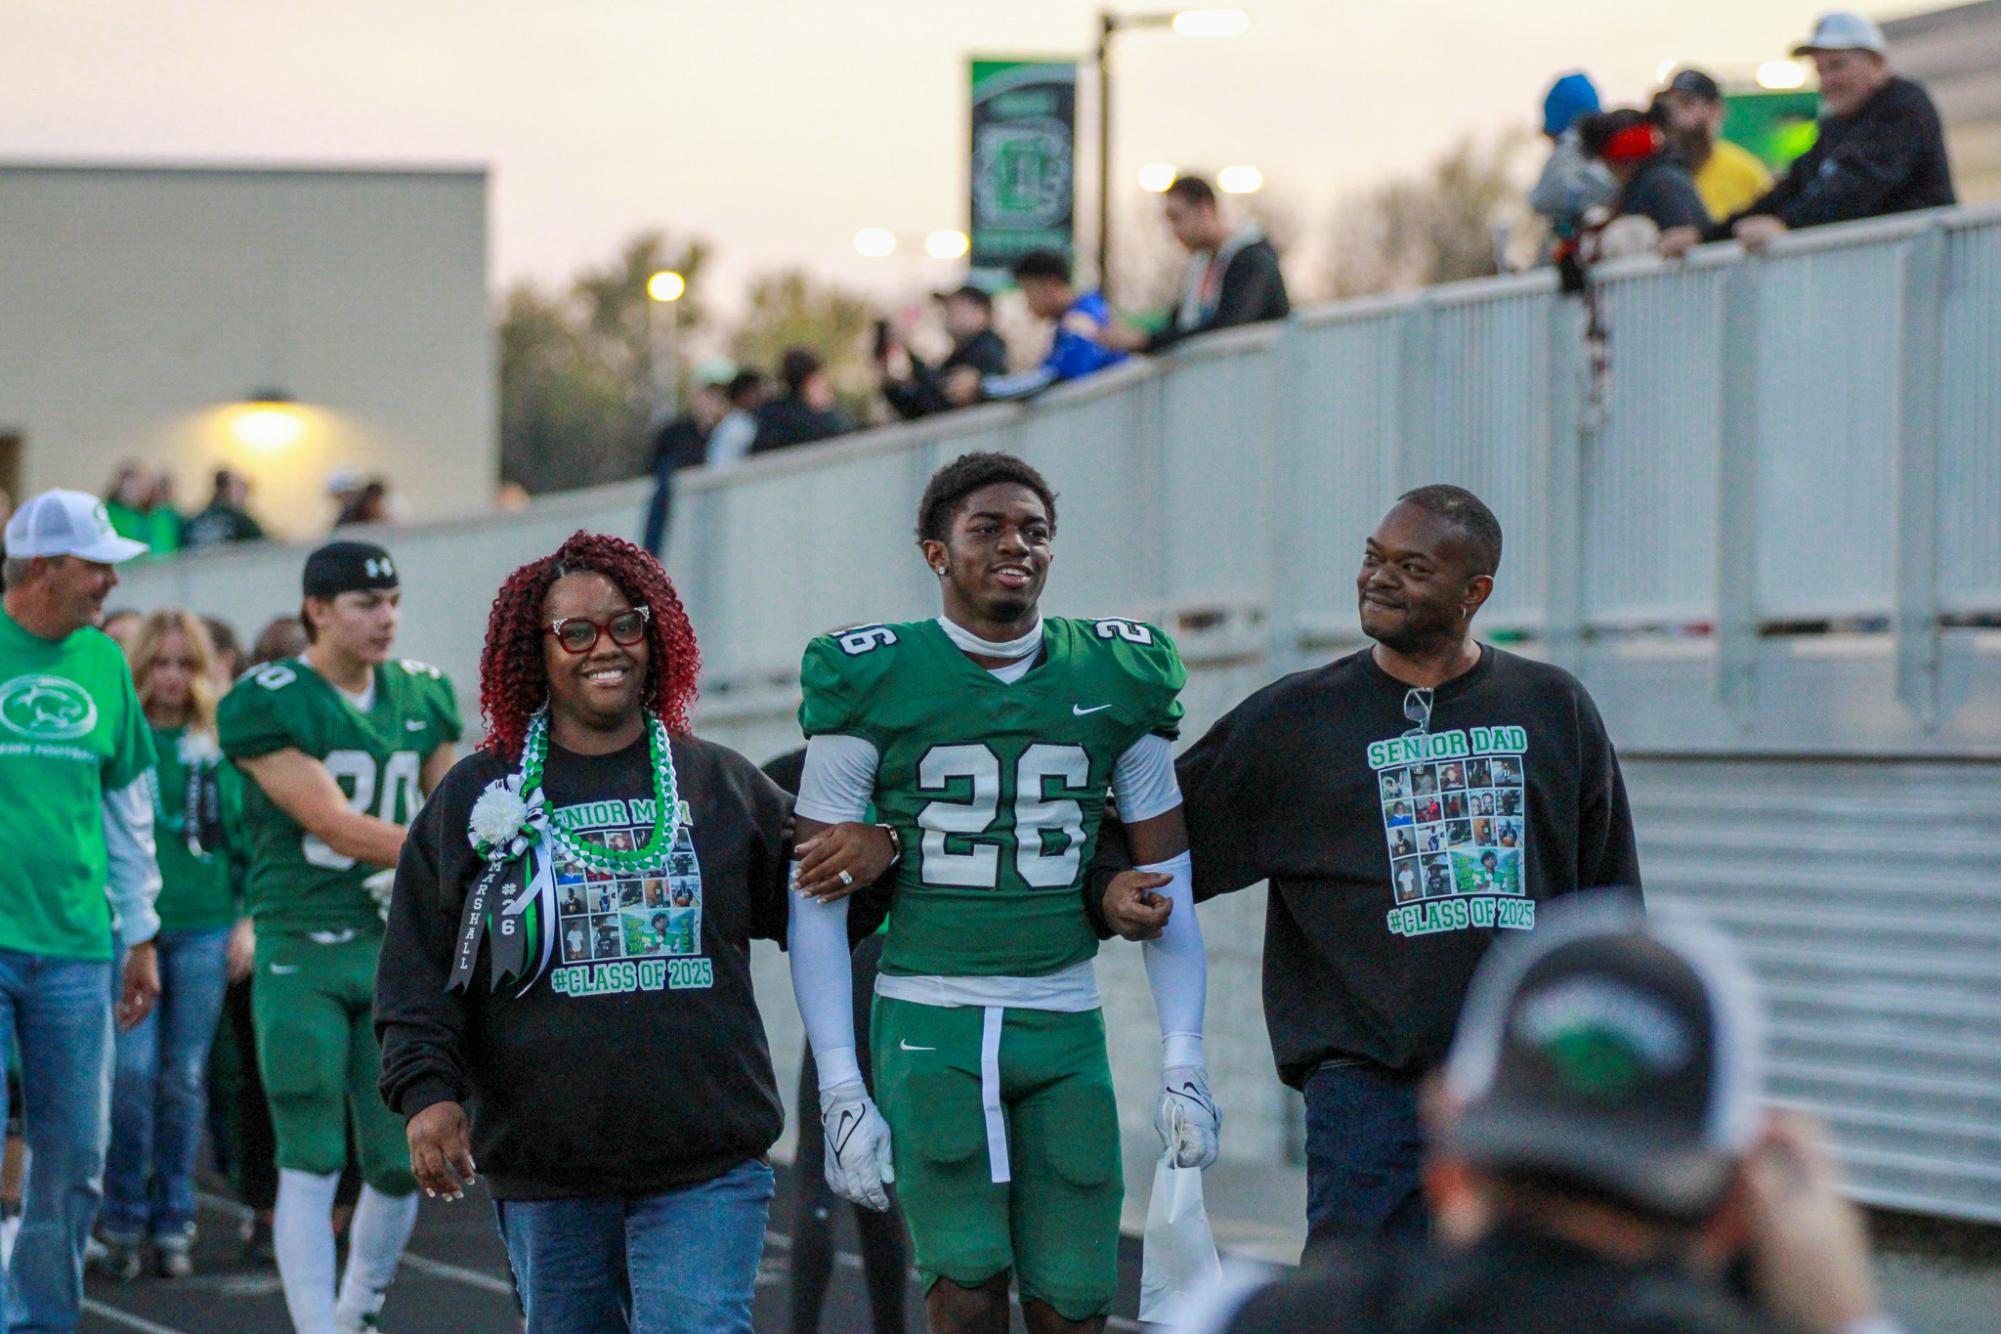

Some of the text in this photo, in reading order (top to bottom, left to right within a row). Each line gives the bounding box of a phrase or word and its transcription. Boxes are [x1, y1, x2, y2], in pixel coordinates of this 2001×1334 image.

[1090, 616, 1154, 646] 2
[1368, 726, 1527, 768] SENIOR DAD
[553, 799, 692, 829] ENIOR MM
[916, 740, 1091, 891] 26
[460, 861, 502, 969] MARSHALL
[1387, 898, 1534, 936] #CLASS OF 2025
[552, 959, 712, 995] #CLASS OF 2025
